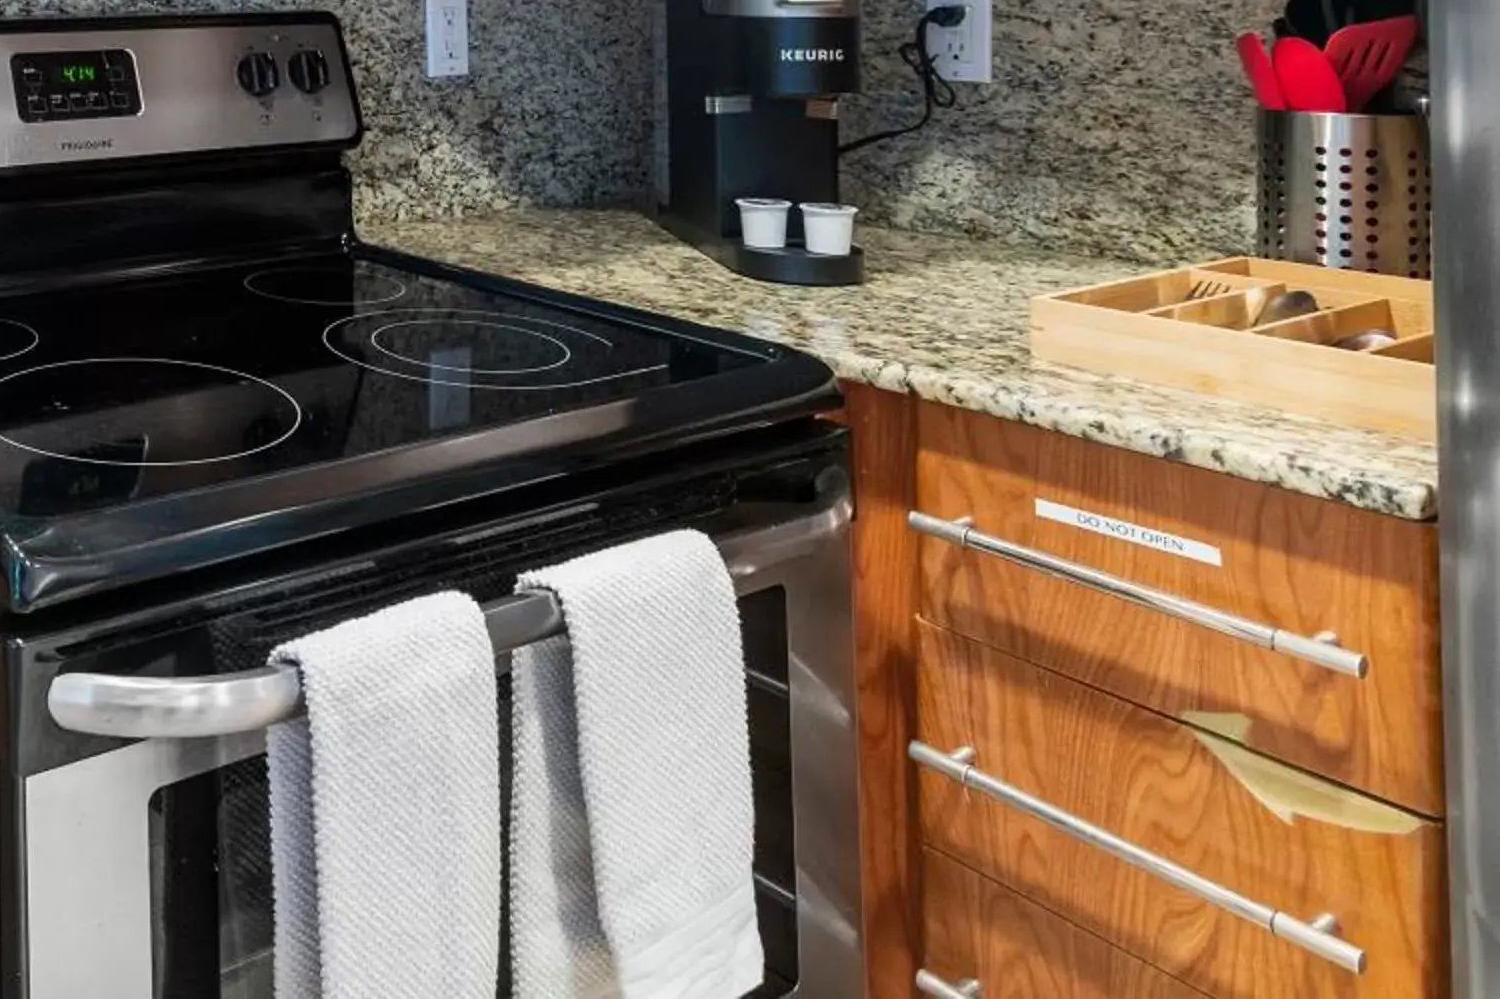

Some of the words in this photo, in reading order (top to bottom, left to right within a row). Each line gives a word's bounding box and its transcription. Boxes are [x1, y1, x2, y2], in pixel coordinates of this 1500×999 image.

[781, 48, 845, 62] KEURIG
[1077, 513, 1101, 528] DO
[1105, 521, 1136, 538] NOT
[1141, 531, 1186, 551] OPEN
